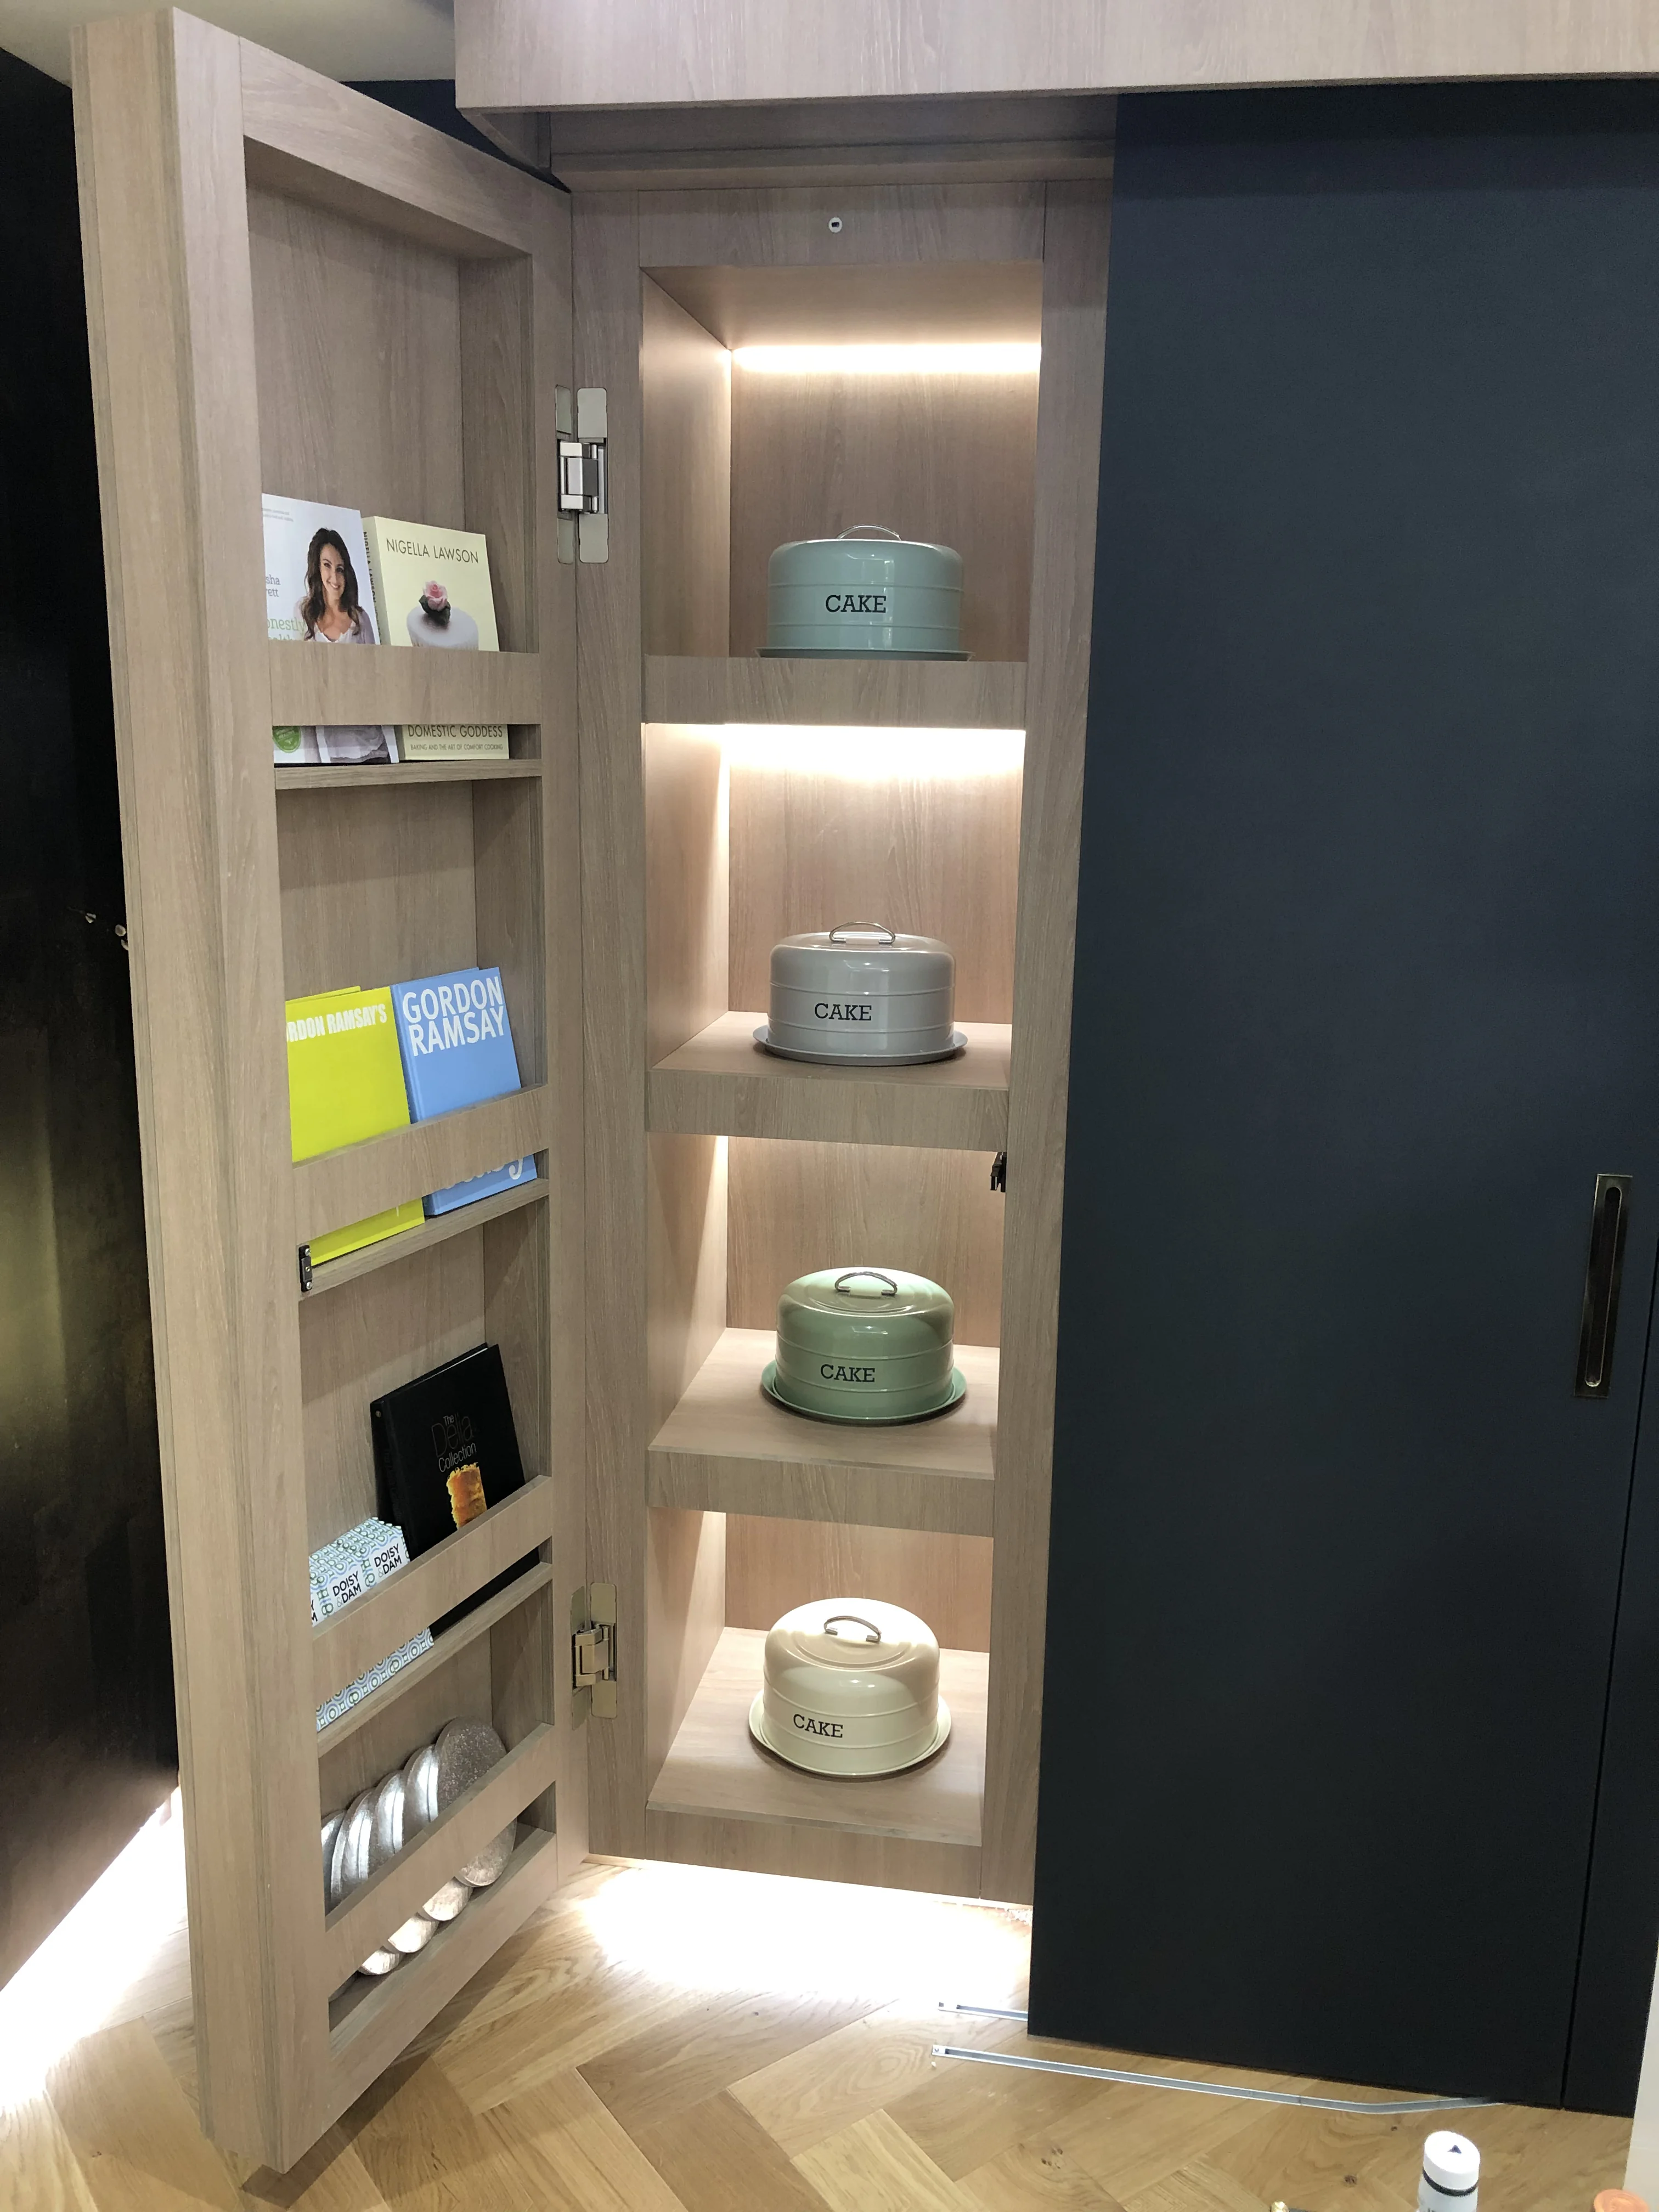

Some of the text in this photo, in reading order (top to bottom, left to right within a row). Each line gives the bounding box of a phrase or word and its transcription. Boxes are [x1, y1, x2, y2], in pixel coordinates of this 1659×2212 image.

[386, 538, 479, 564] NIGELLA LAWSON
[825, 595, 887, 613] CAKE
[408, 724, 503, 738] DOMESTIC GODDESS
[402, 976, 503, 1023] GORDON
[814, 1002, 872, 1022] CAKE
[286, 1003, 387, 1042] RDON RAMSAY'S
[409, 1006, 504, 1057] RAMSAY
[820, 1364, 876, 1383] CAKE
[443, 1415, 455, 1426] The
[431, 1412, 474, 1458] Delia
[438, 1443, 477, 1472] Collection
[374, 1543, 399, 1567] DOISY
[332, 1570, 359, 1597] DOISY
[793, 1713, 844, 1739] CAKE
